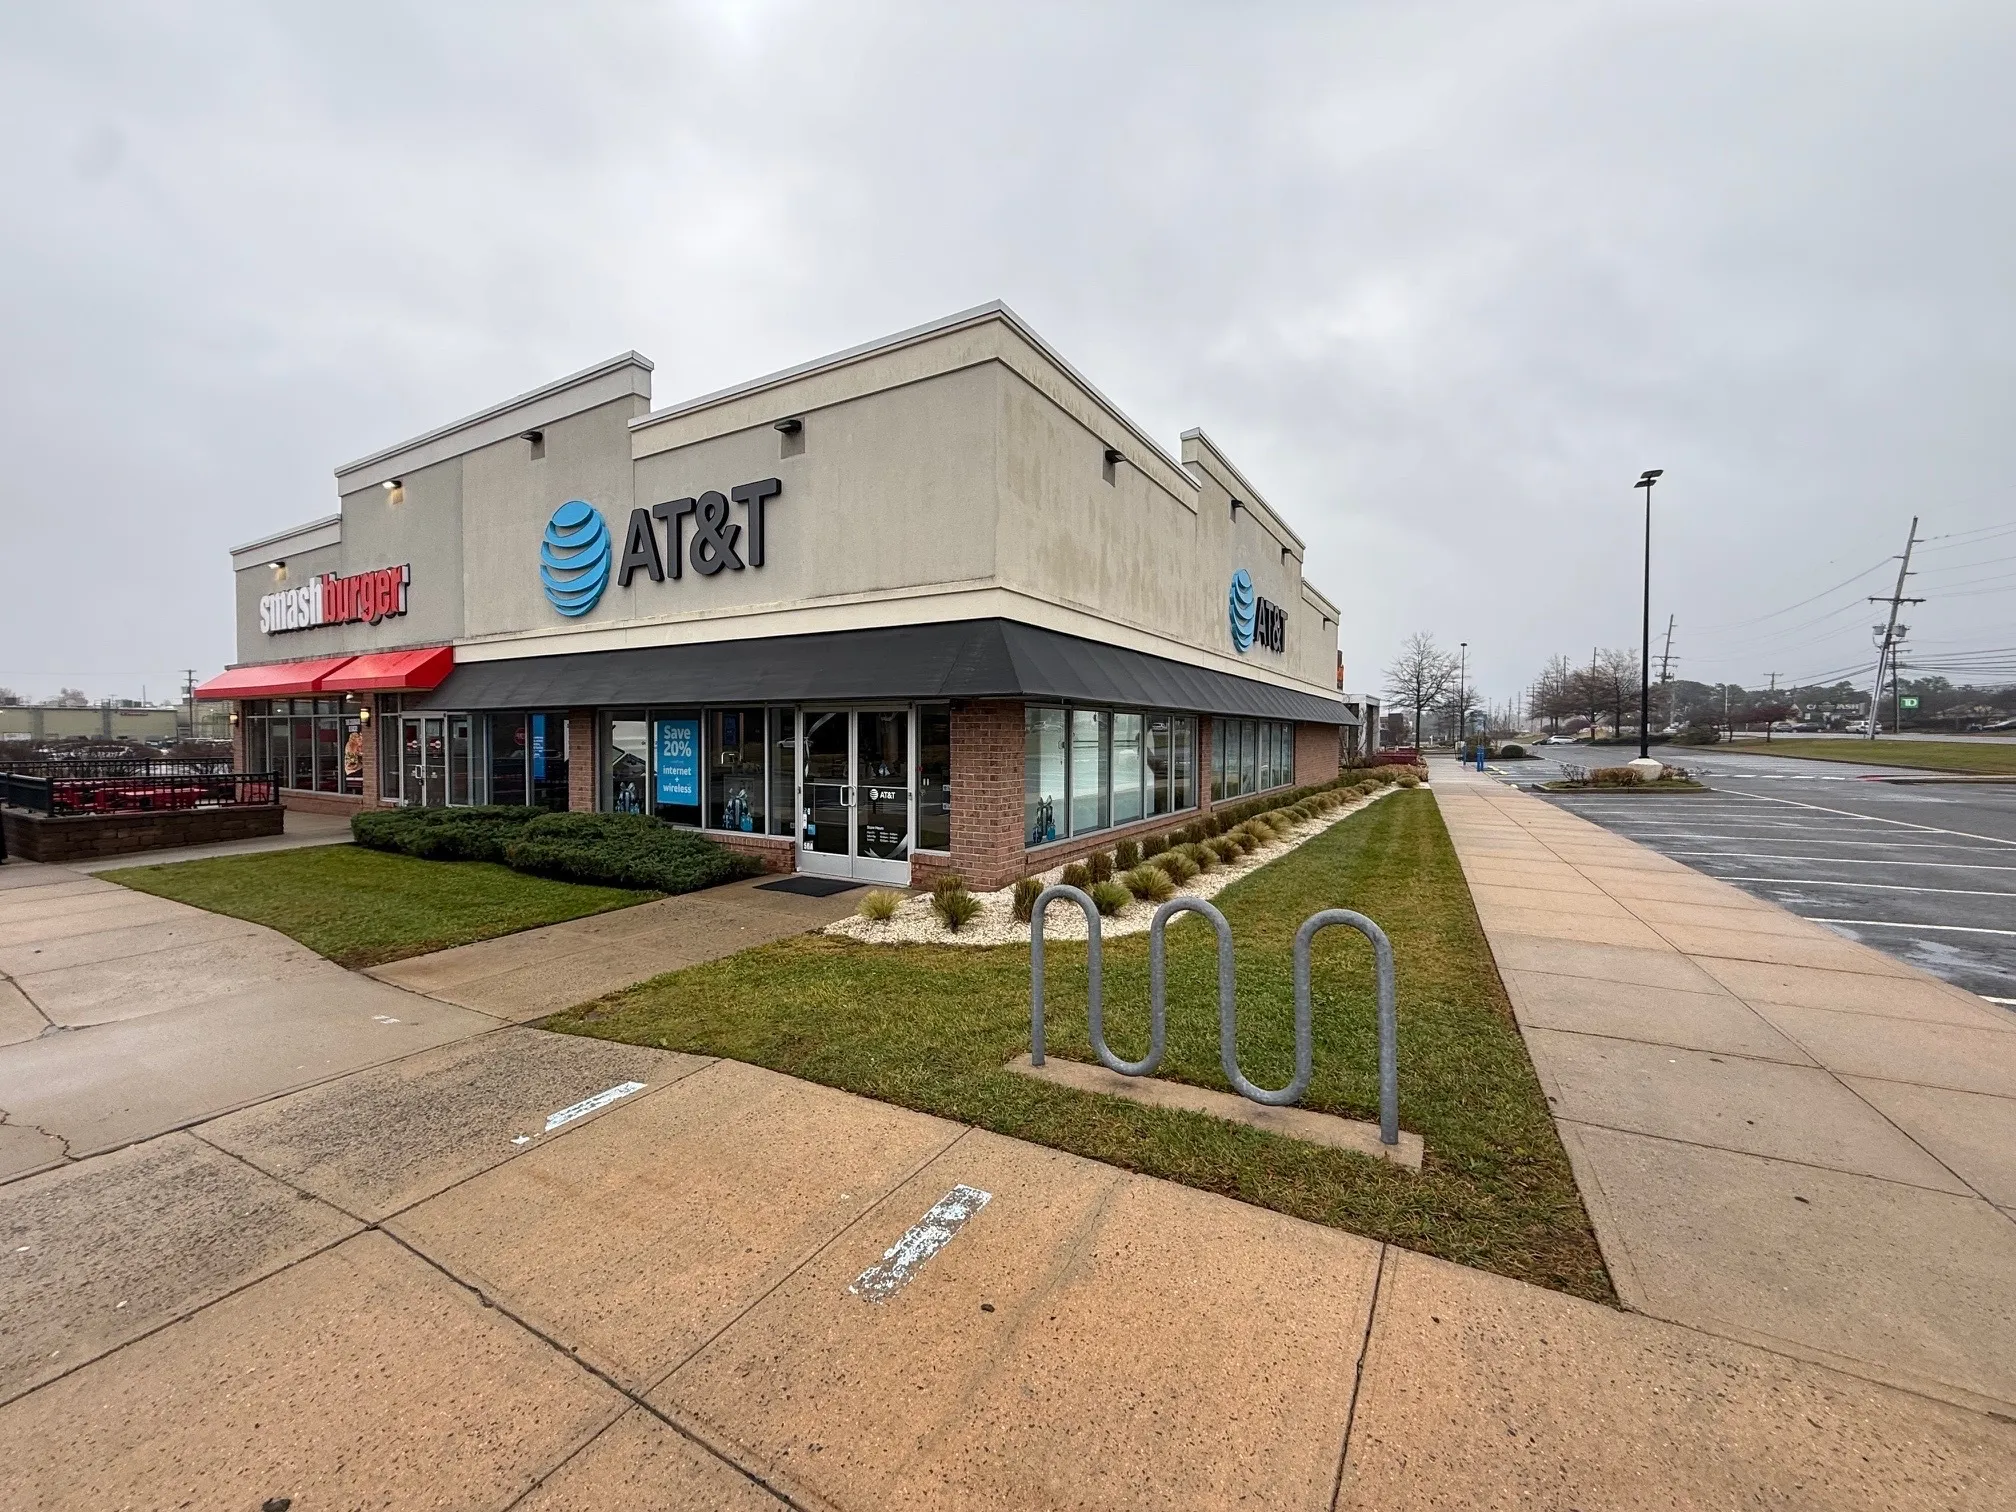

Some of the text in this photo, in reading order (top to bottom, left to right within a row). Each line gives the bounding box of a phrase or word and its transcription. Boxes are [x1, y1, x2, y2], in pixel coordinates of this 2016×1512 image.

[618, 477, 782, 587] AT&T
[260, 563, 411, 636] smashburger
[1253, 597, 1288, 653] AT&T
[1902, 698, 1917, 707] TD
[664, 725, 691, 740] Save
[663, 740, 692, 757] 20%
[663, 765, 692, 776] internet
[663, 783, 692, 794] wireless
[880, 791, 896, 799] AT&T
